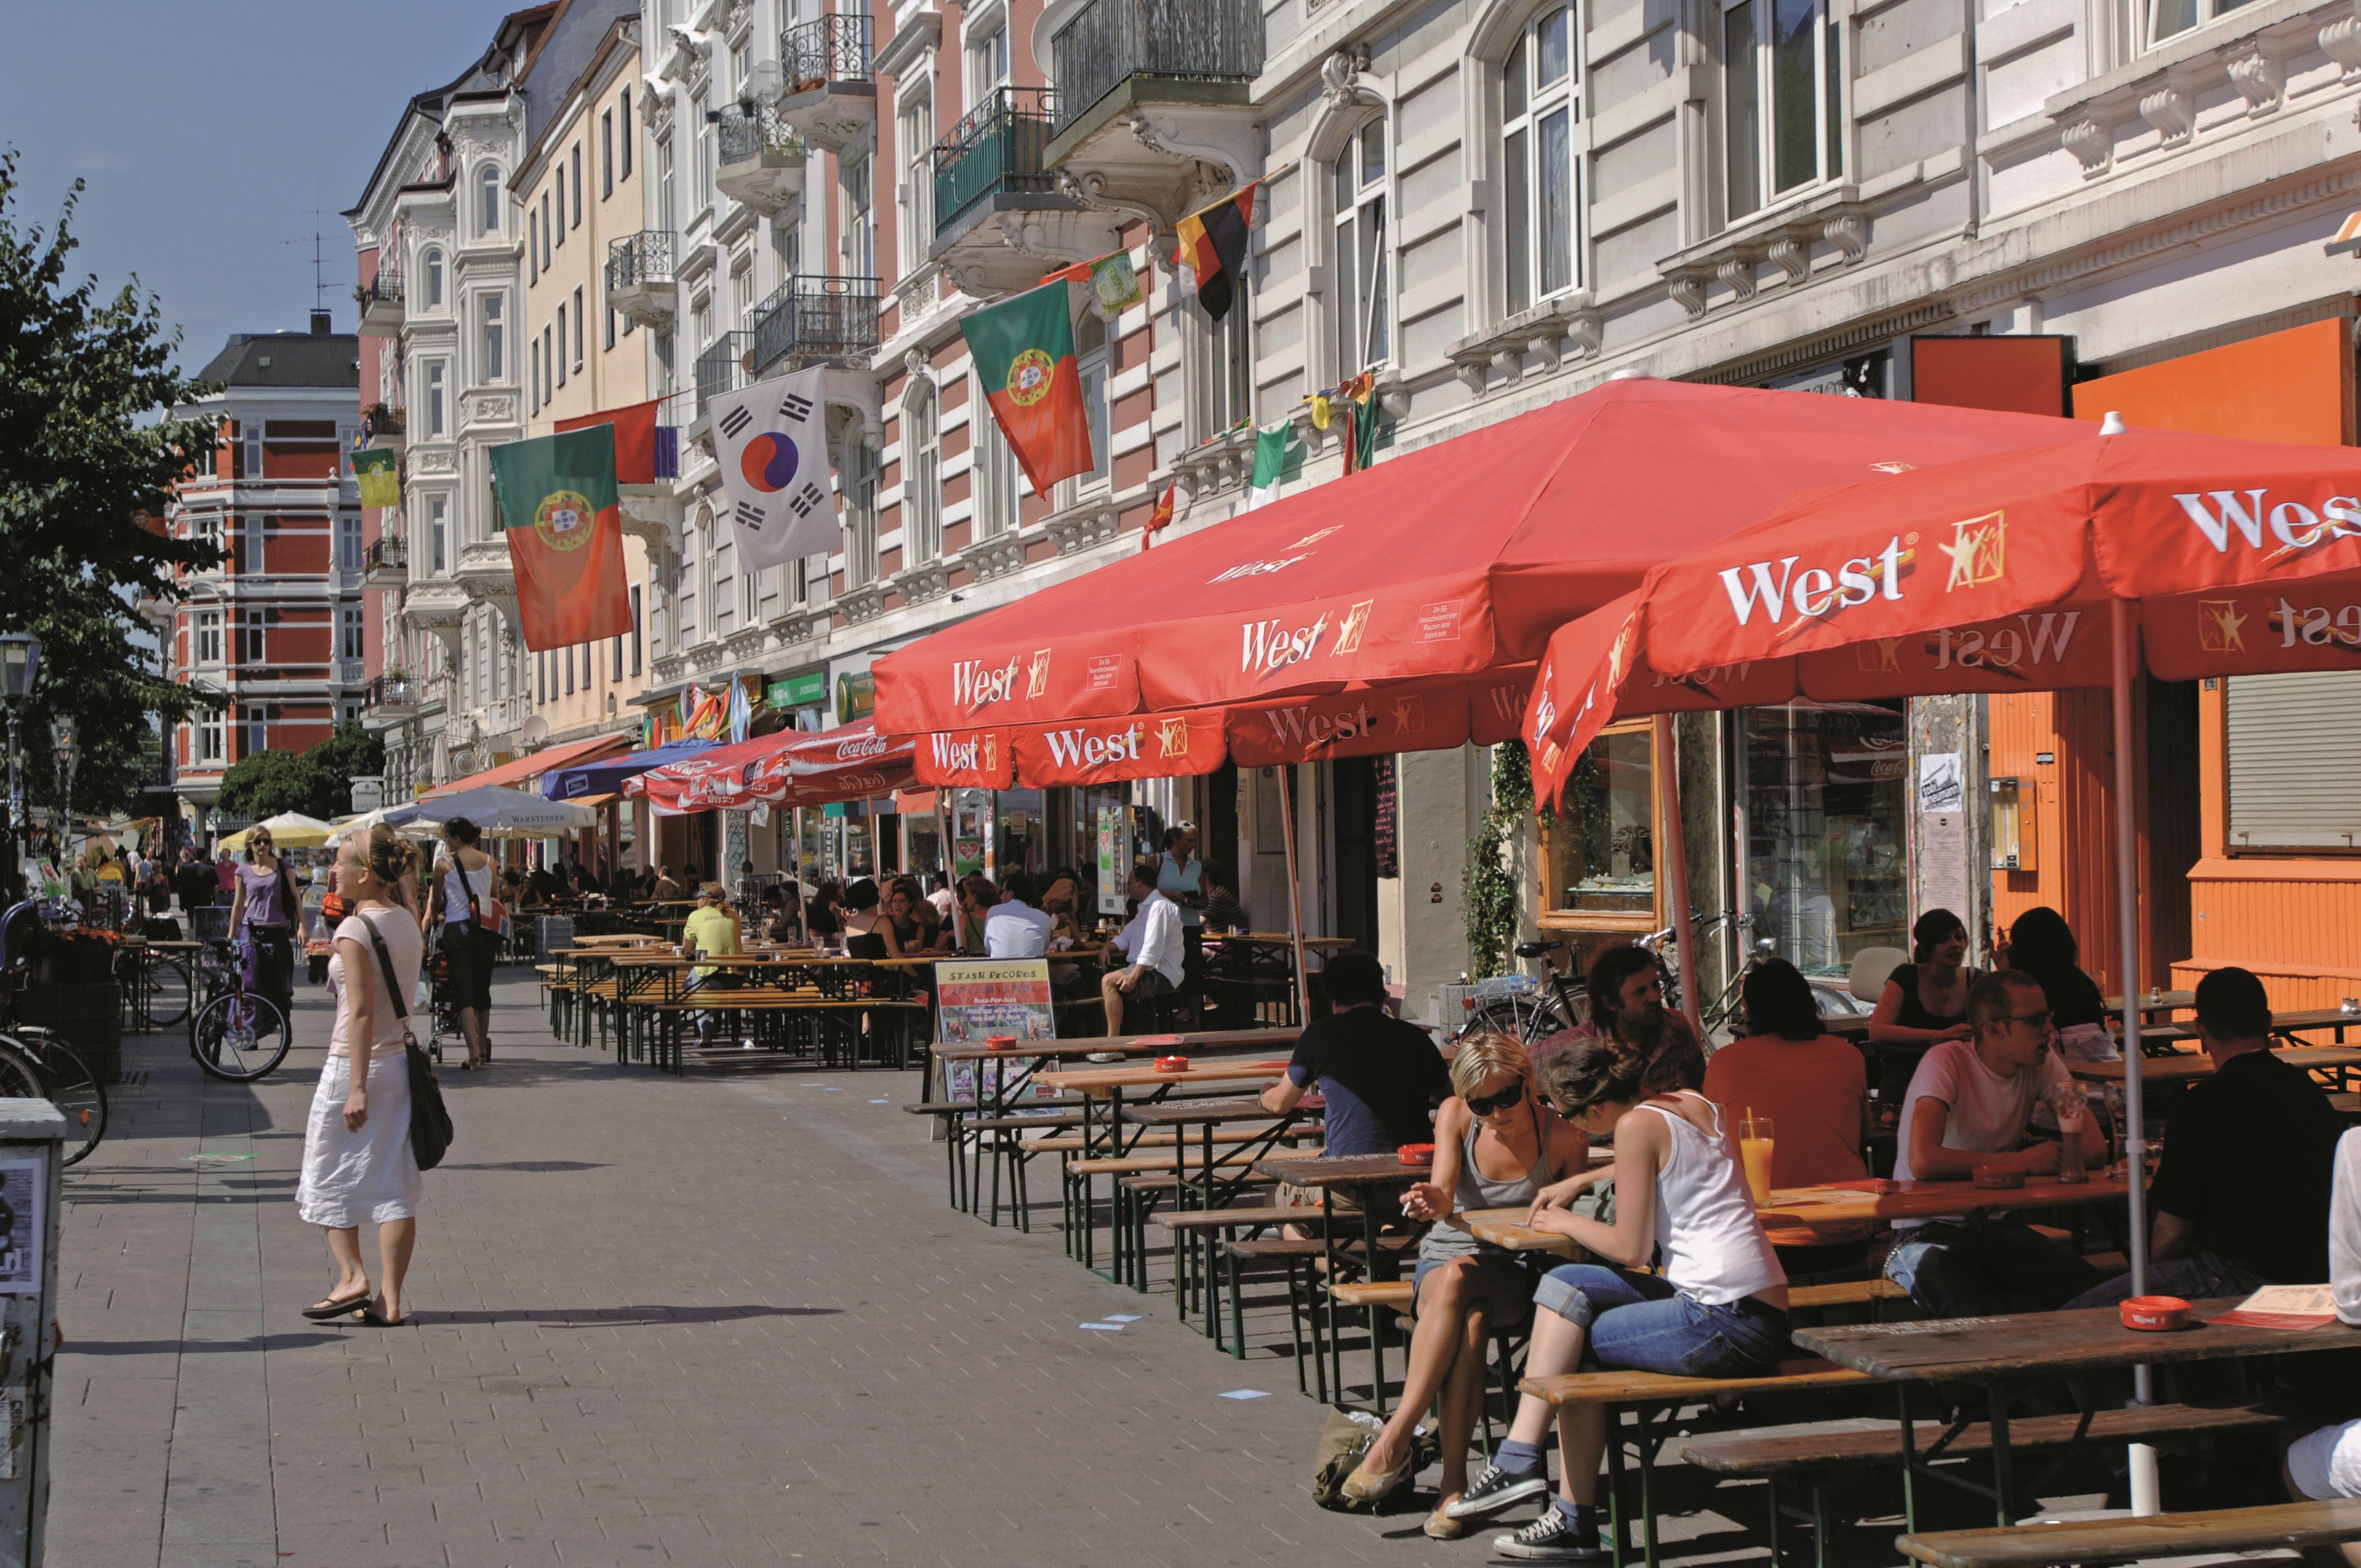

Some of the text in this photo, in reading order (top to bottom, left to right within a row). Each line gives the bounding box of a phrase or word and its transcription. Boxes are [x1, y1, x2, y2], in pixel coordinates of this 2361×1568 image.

[2172, 488, 2361, 553] Wes
[1206, 552, 1309, 585] West
[1718, 535, 1906, 627] West
[1241, 611, 1328, 673] West
[953, 655, 1018, 706] West
[1264, 700, 1370, 747] West
[836, 736, 887, 760] Coca-Cola
[932, 733, 978, 770] West
[1044, 723, 1140, 767] West
[1923, 779, 1938, 797] tobi
[1928, 785, 1959, 804] neumann
[511, 814, 565, 824] WARSTEINER
[949, 971, 1036, 981] STASH RECORDS
